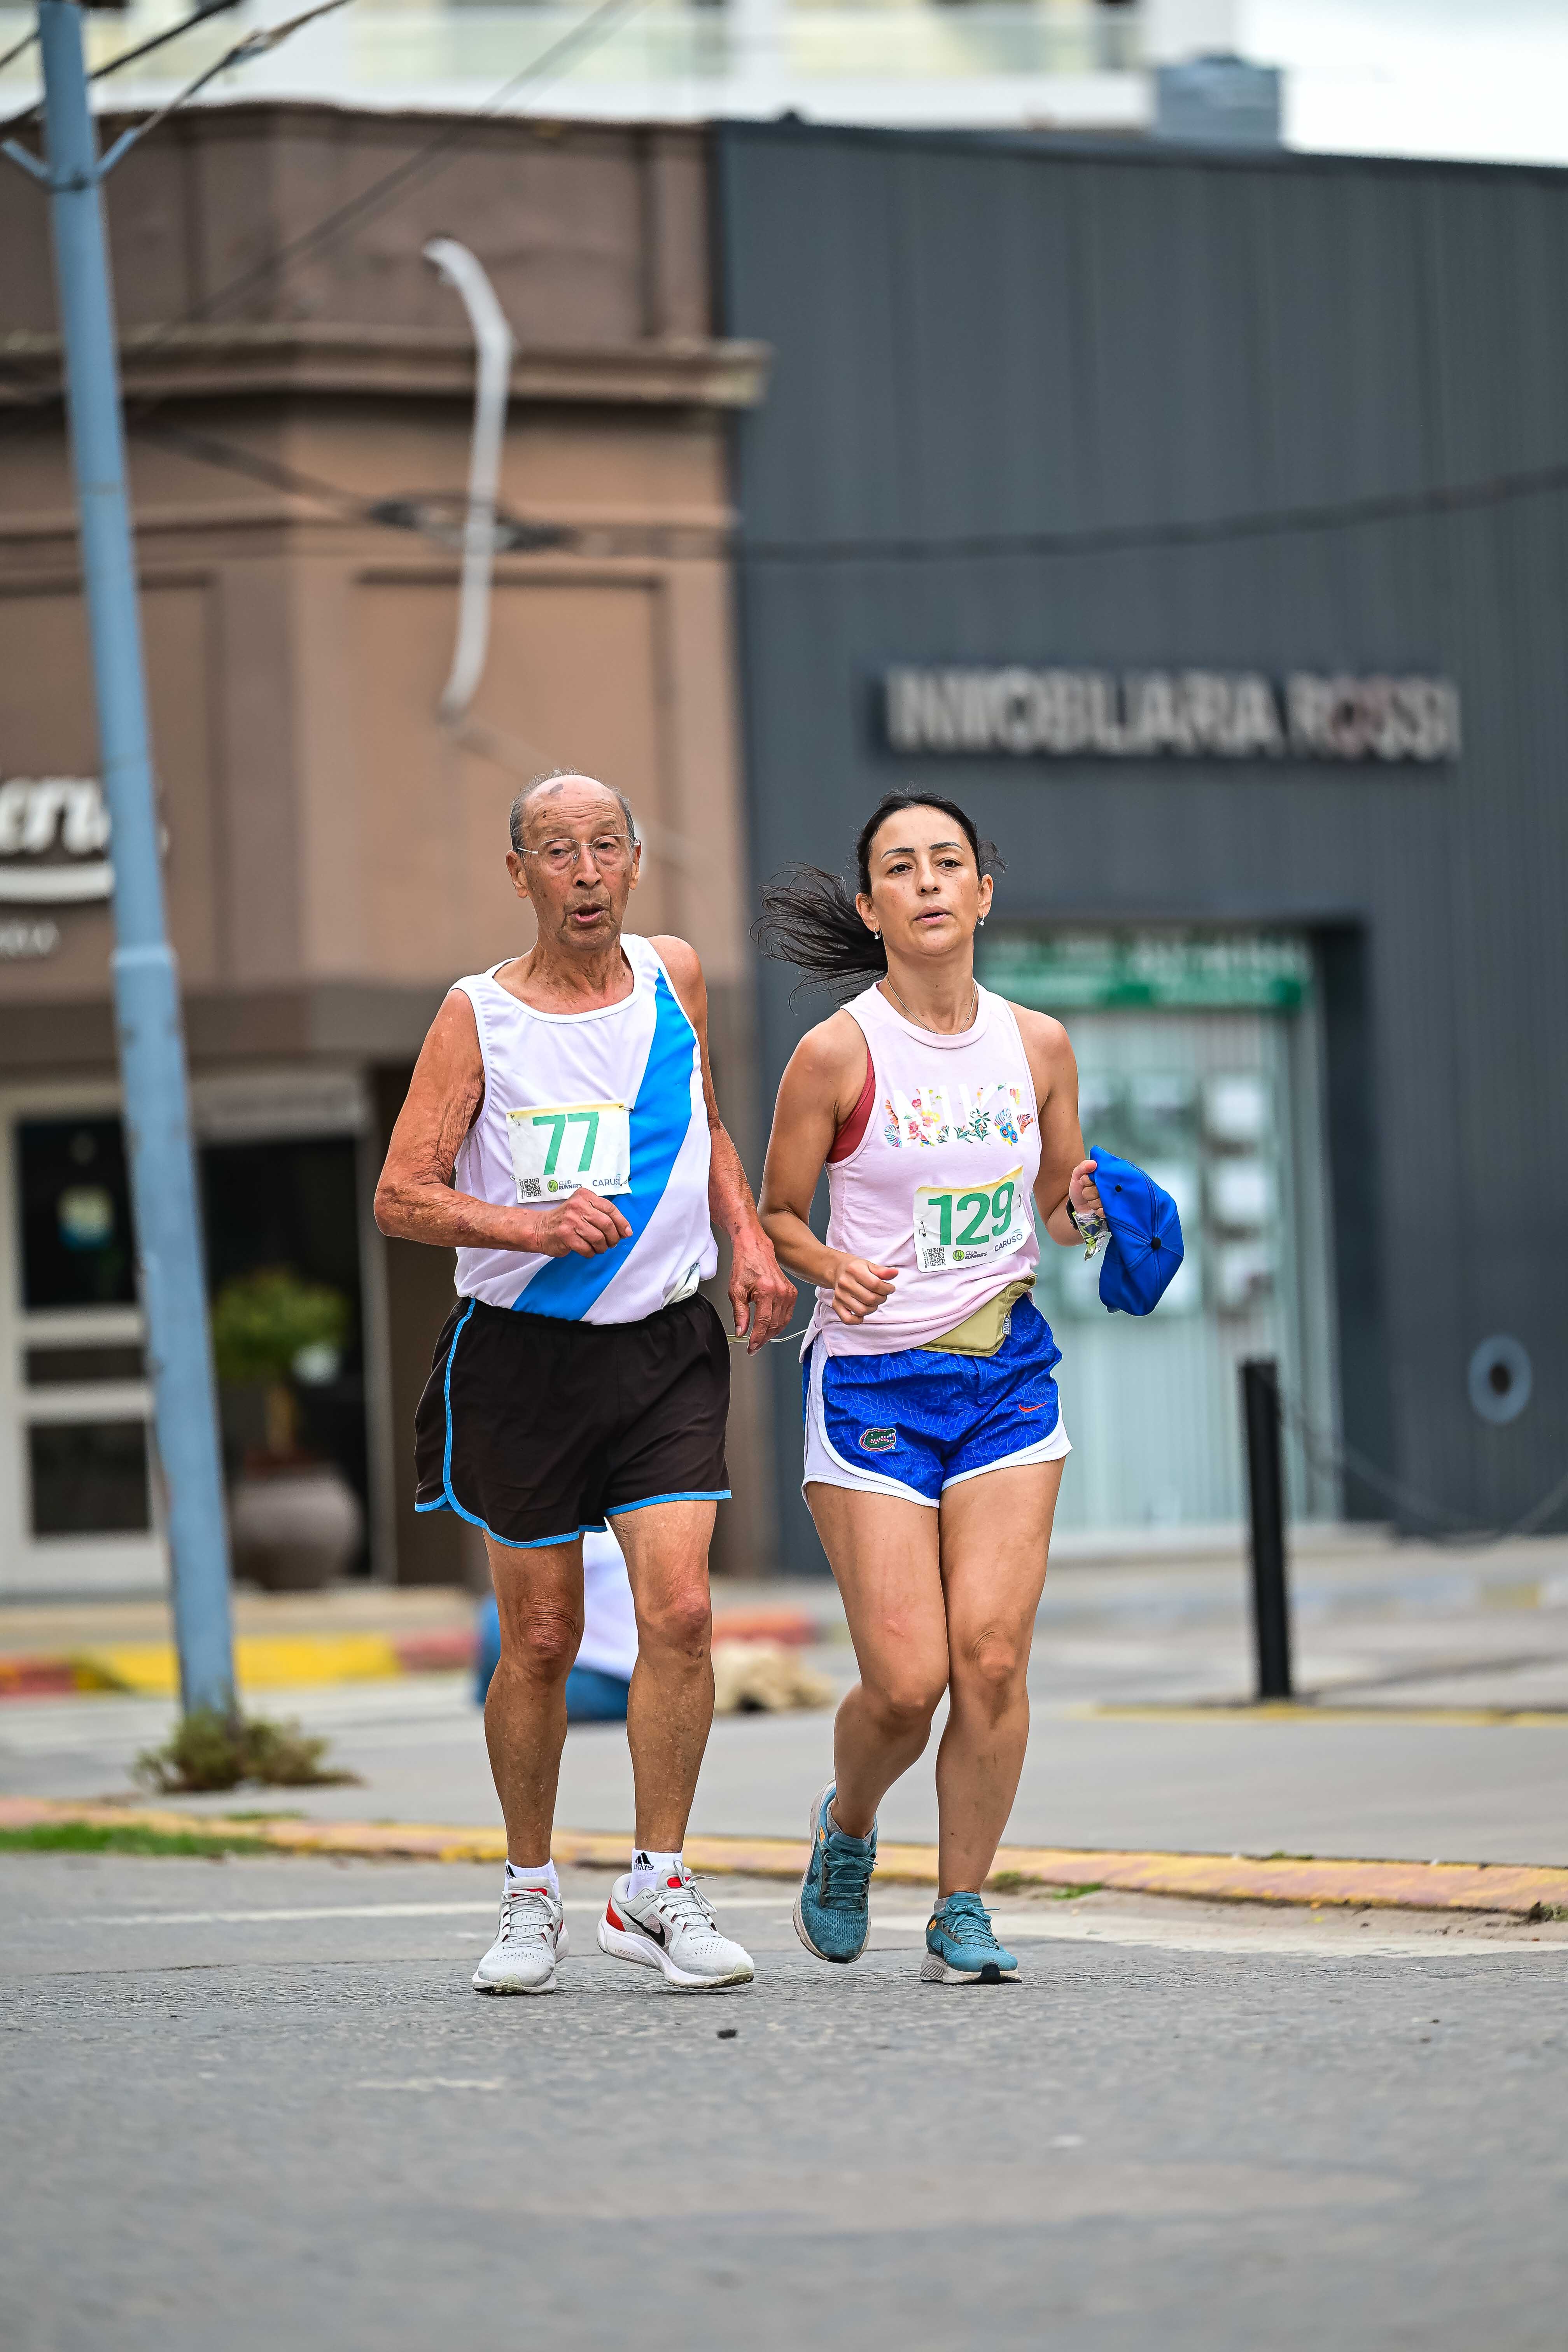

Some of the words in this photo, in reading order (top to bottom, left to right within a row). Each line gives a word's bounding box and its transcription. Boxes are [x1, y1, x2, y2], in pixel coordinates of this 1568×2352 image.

[1286, 672, 1461, 763] ROSSI
[532, 1112, 599, 1175] 77
[592, 1178, 621, 1187] CARUSO
[928, 1181, 1014, 1246] 129
[994, 1234, 1023, 1252] CARUSO
